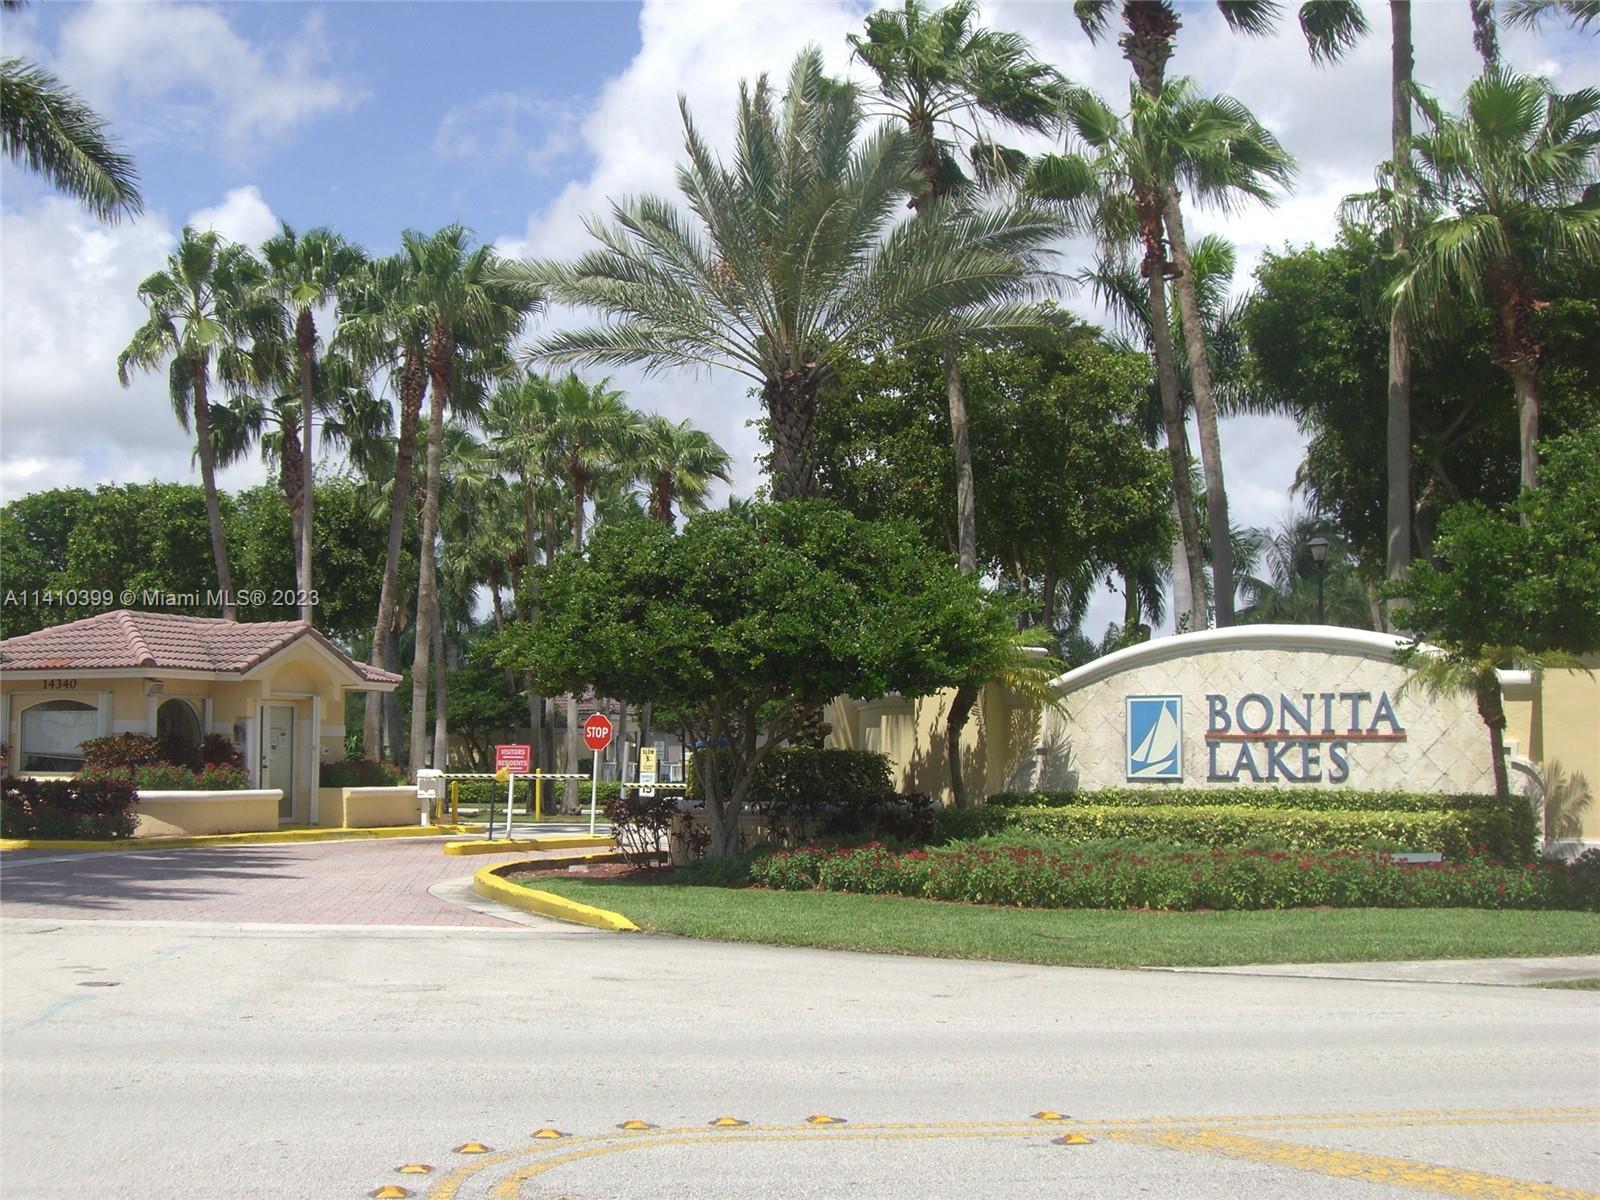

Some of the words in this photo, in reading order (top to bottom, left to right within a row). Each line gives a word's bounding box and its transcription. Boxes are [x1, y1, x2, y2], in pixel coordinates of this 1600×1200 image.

[42, 679, 78, 689] 14340
[1205, 690, 1406, 734] BONITA
[586, 726, 609, 738] STOP
[1206, 739, 1351, 783] LAKES
